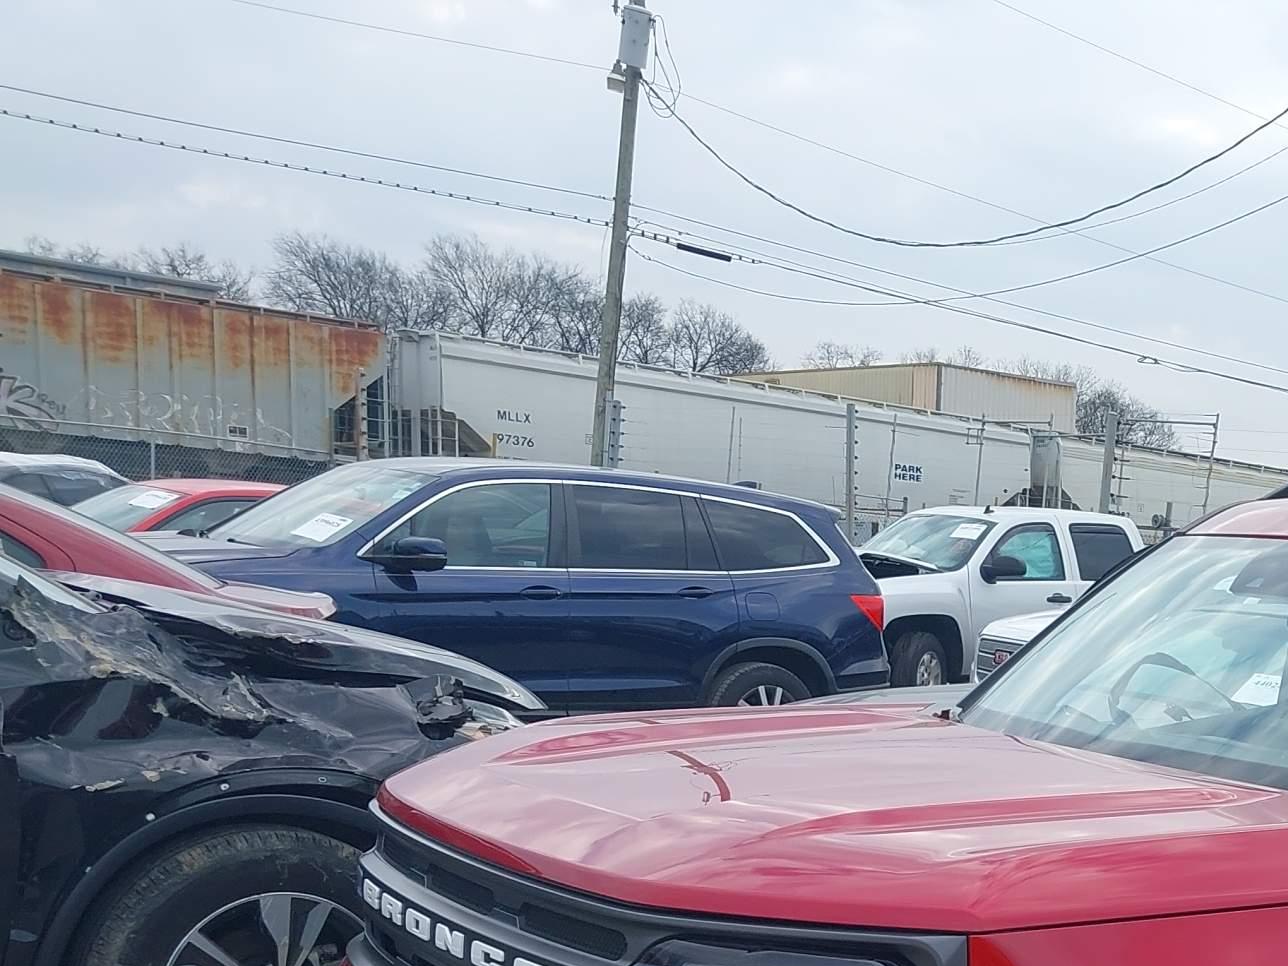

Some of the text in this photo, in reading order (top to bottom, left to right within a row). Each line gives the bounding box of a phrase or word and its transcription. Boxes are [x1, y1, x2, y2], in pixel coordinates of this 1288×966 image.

[497, 409, 532, 423] MLLX
[895, 463, 922, 474] PARK
[894, 472, 922, 482] HERE
